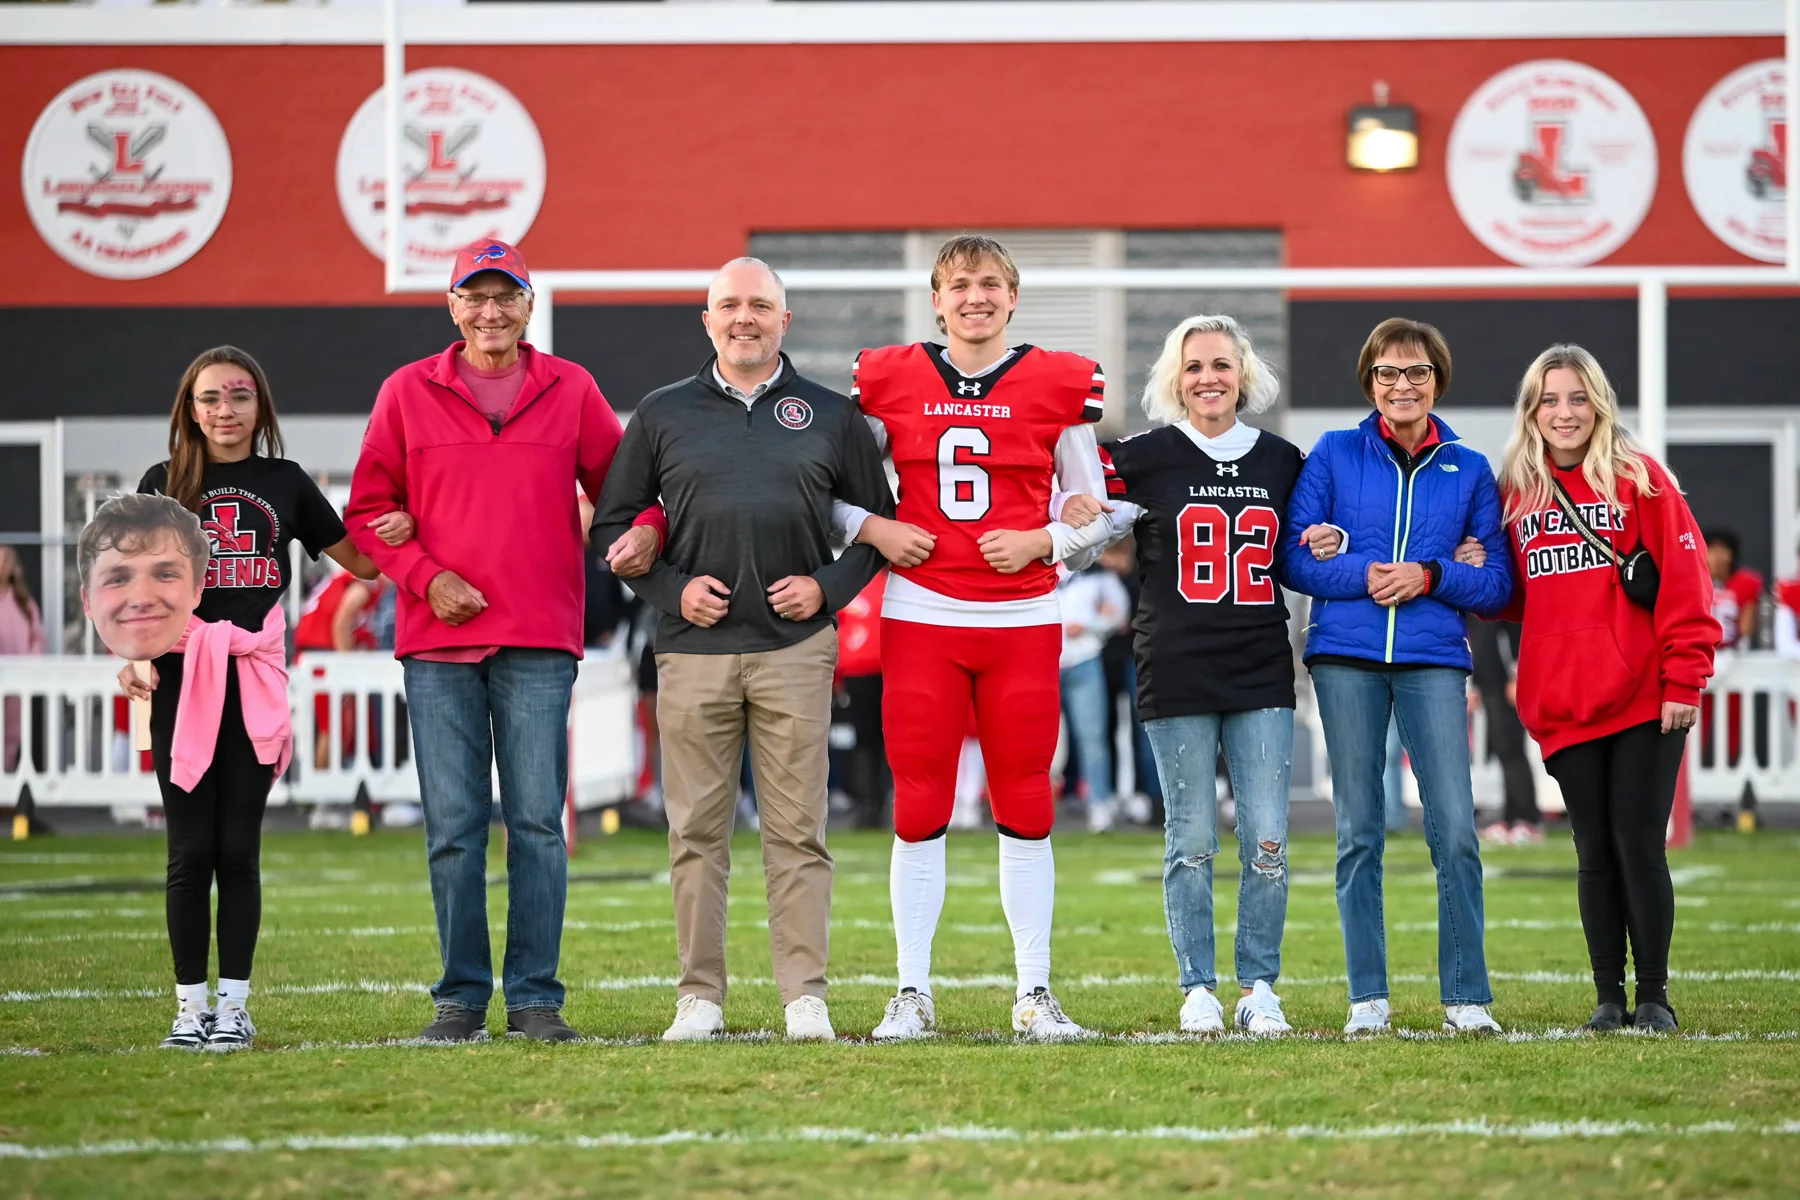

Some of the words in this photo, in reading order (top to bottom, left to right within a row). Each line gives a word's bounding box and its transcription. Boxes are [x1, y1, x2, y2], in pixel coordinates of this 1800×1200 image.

[924, 403, 1011, 418] LANCASTER
[937, 426, 991, 522] 6
[208, 486, 237, 497] BUILD
[238, 488, 257, 500] THE
[1189, 486, 1269, 499] LANCASTER
[1515, 502, 1625, 554] LANCATER
[1176, 503, 1280, 606] 82
[204, 556, 282, 589] GENDS
